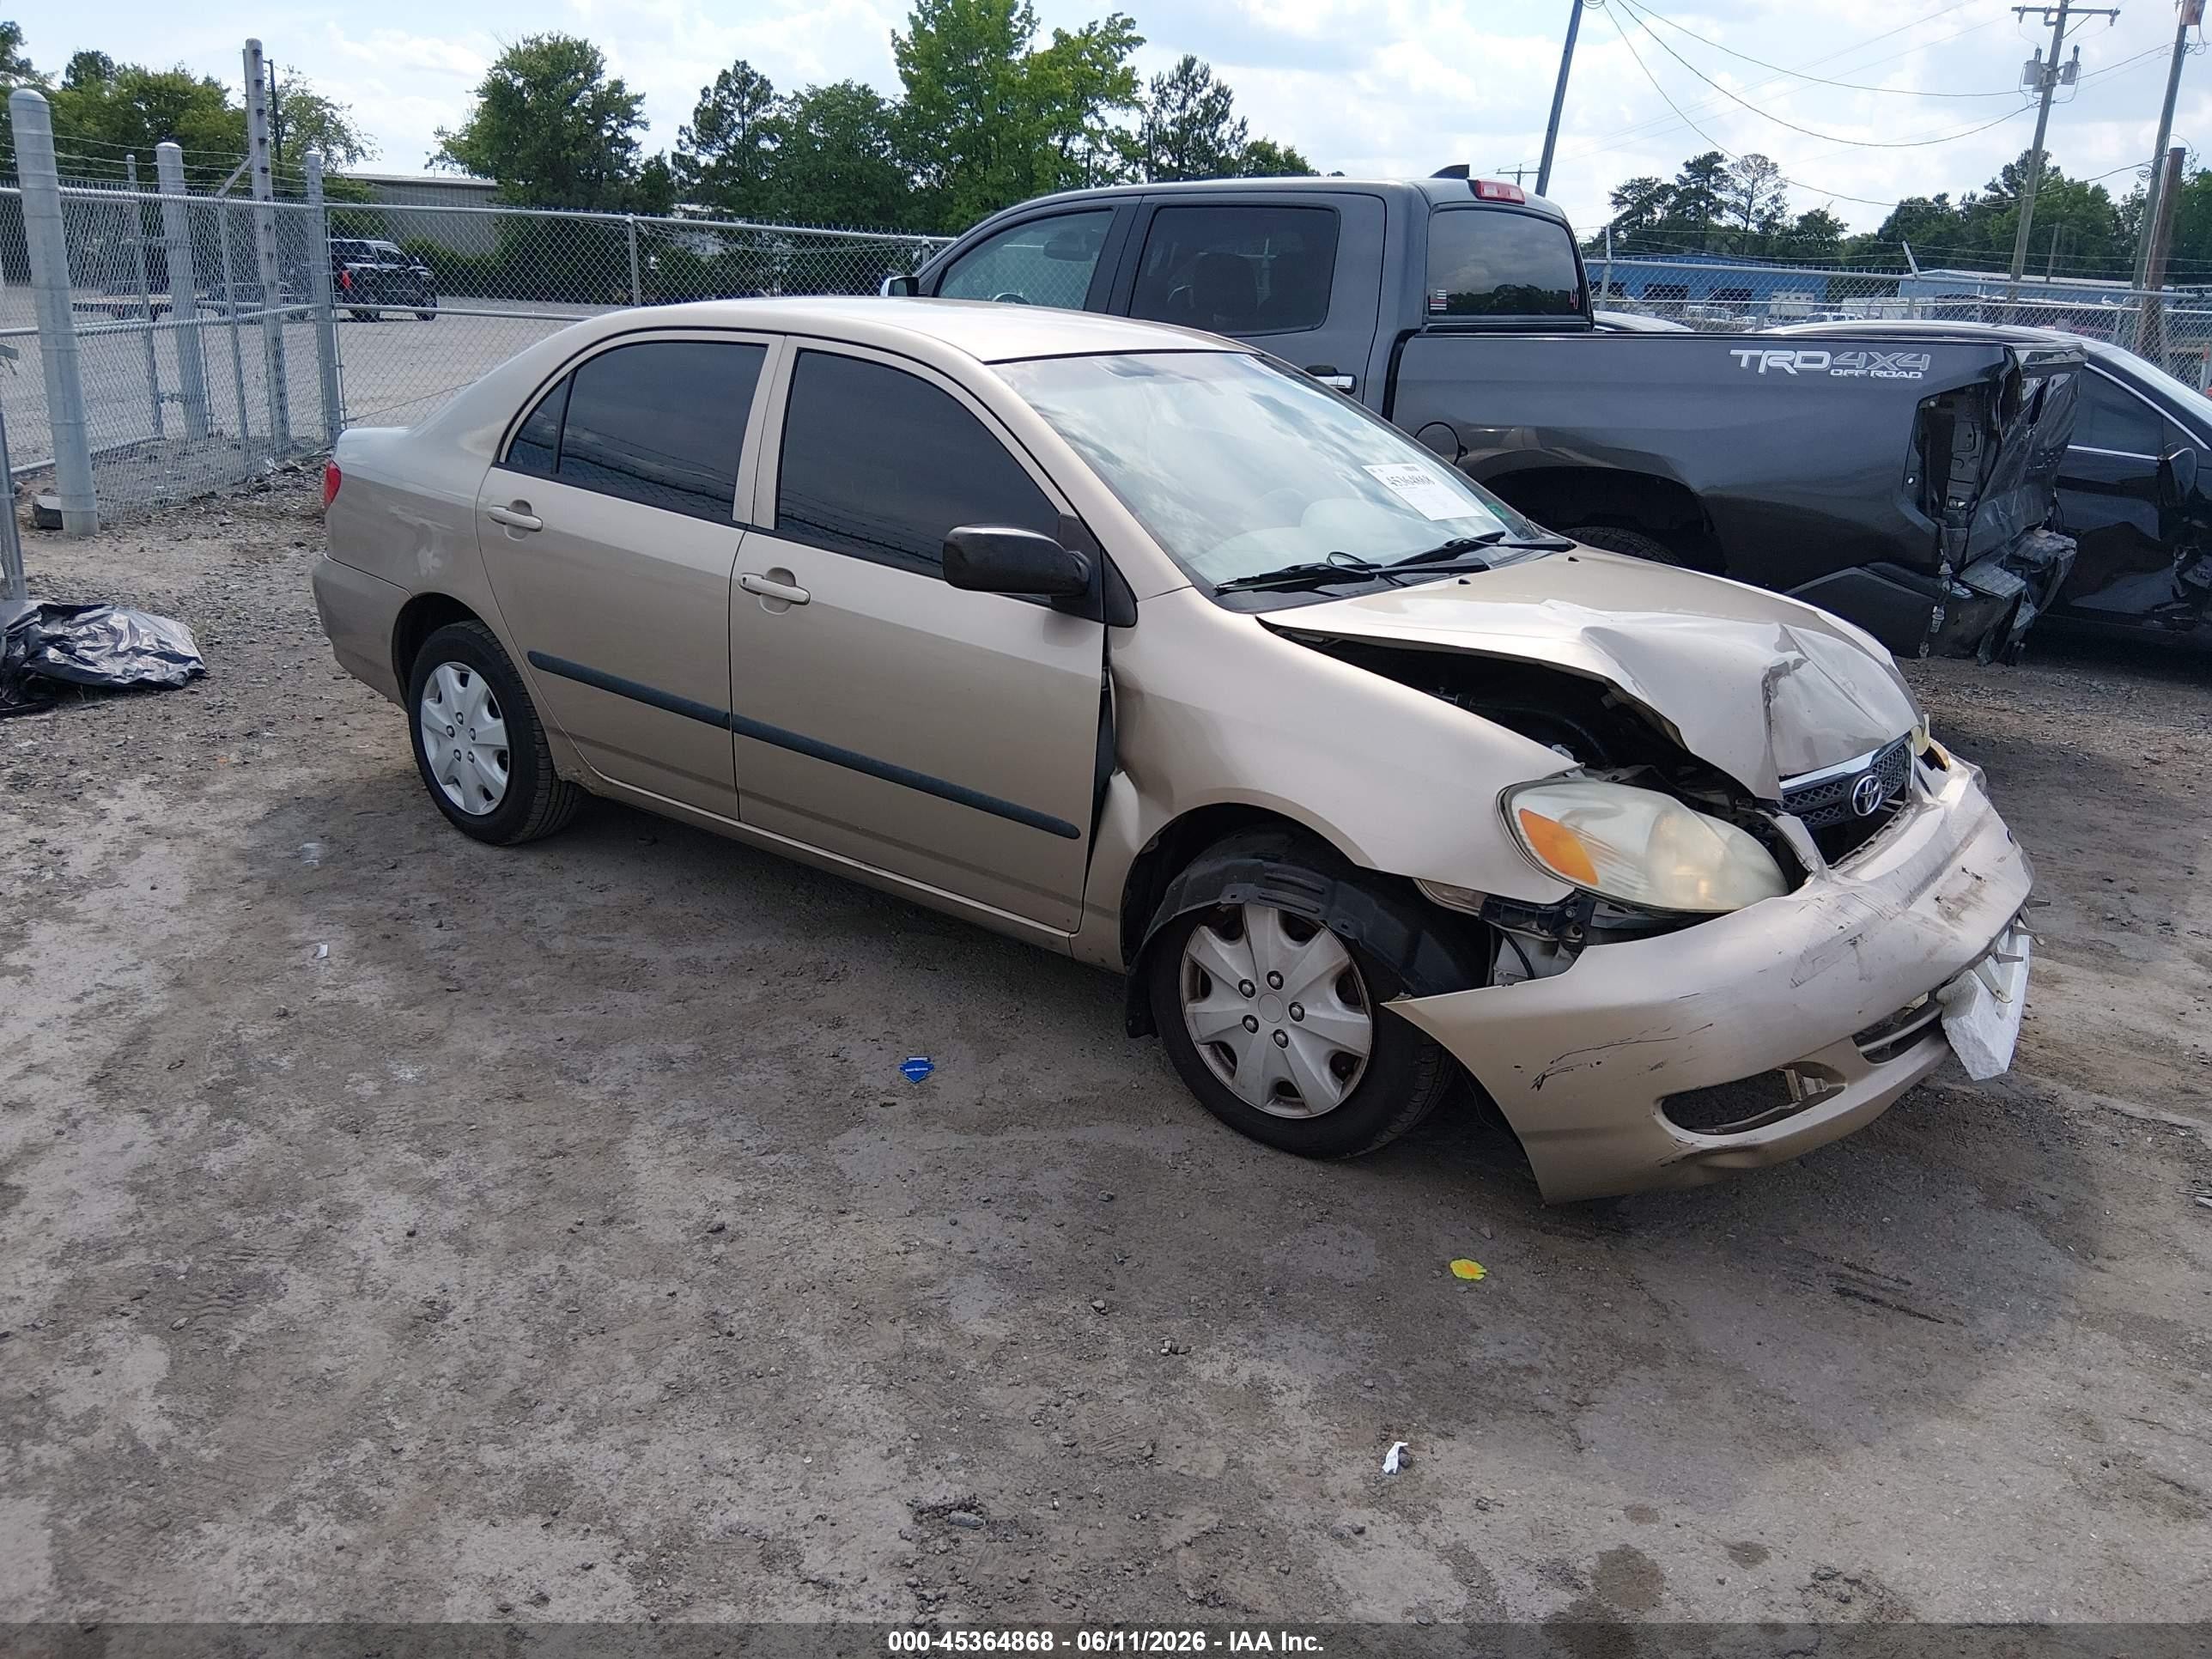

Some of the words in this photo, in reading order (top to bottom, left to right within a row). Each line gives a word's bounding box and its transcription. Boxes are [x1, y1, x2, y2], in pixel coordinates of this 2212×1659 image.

[1729, 349, 1832, 375] TRD
[1832, 351, 1931, 372] 4X4
[1830, 368, 1869, 377] OFF
[1870, 369, 1923, 379] ROAD
